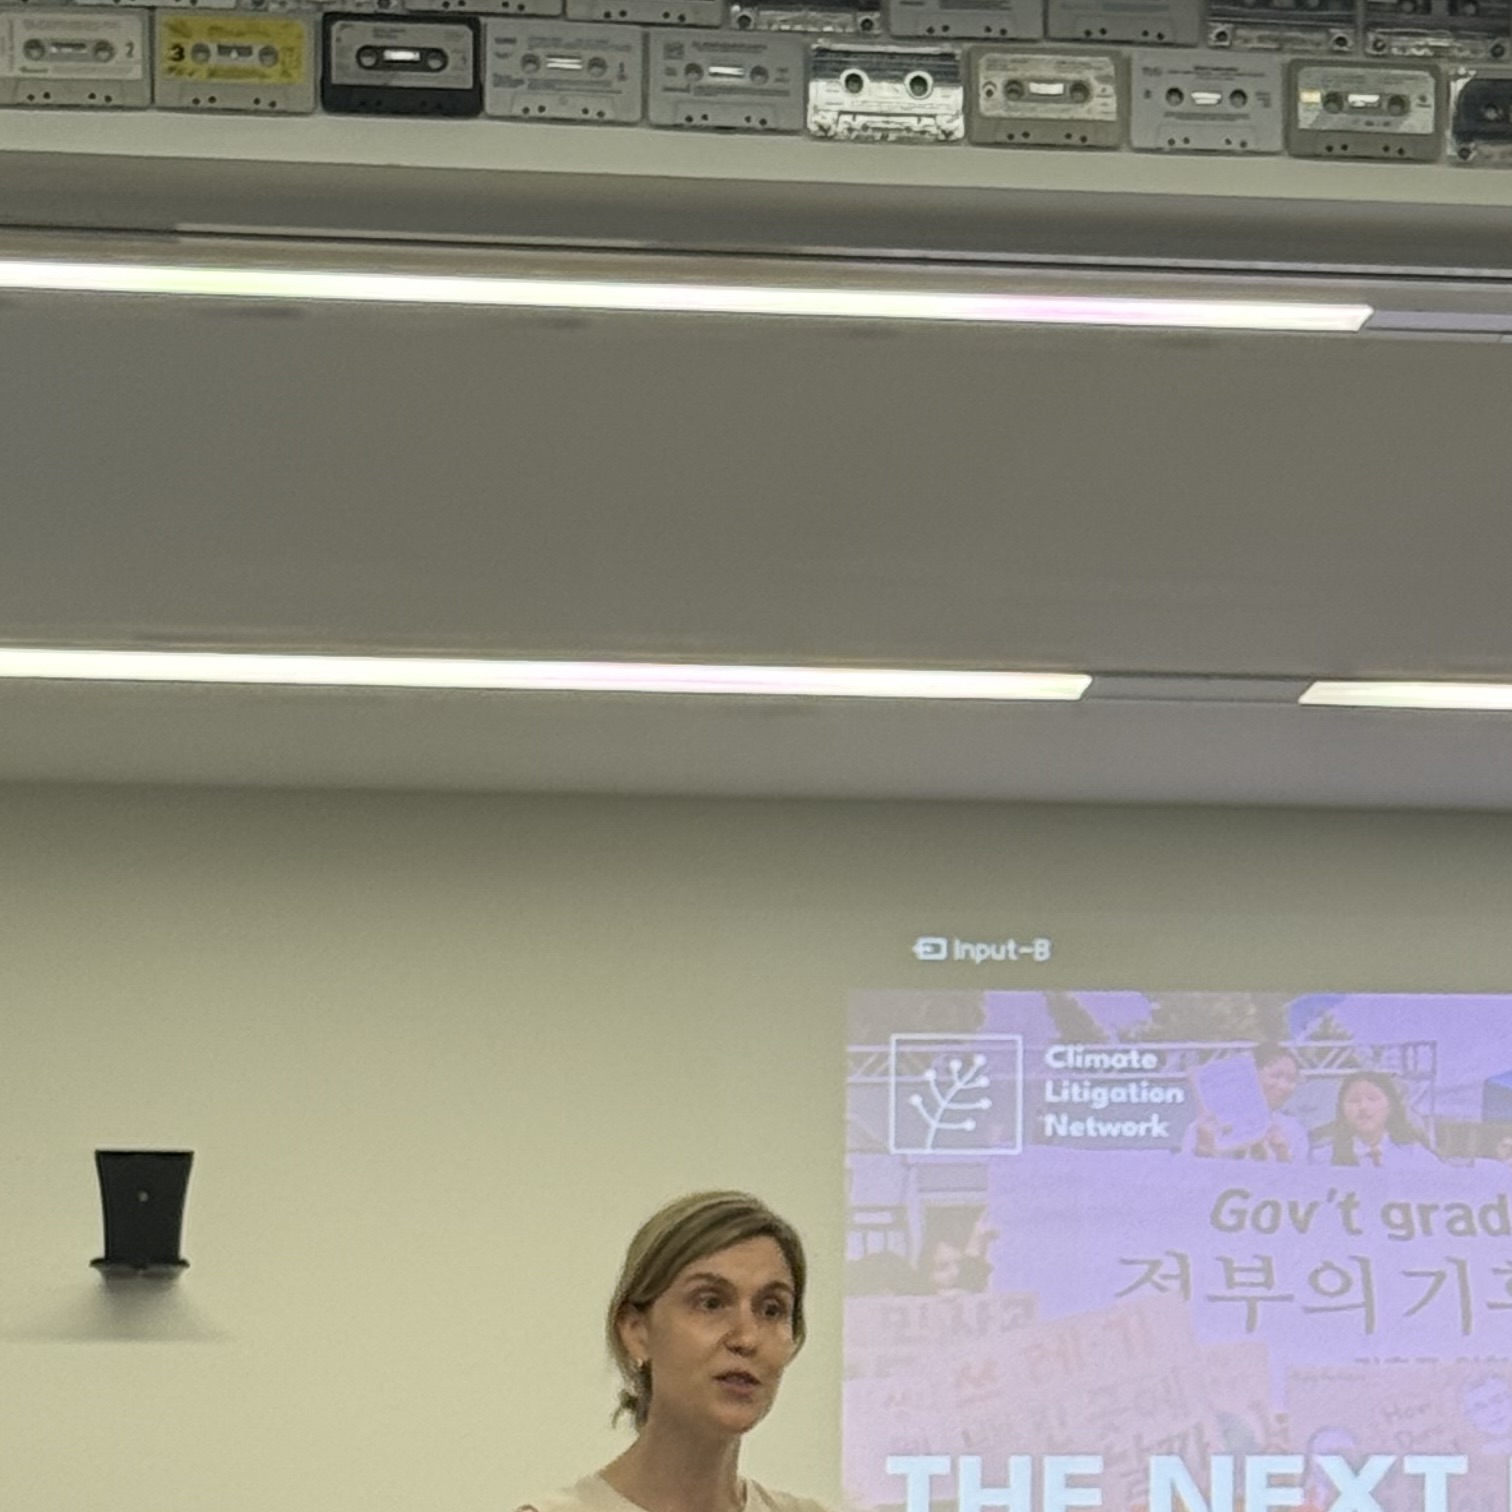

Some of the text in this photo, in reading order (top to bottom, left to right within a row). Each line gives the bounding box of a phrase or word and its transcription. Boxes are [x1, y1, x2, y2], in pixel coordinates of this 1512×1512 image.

[170, 44, 186, 62] 3
[1045, 1044, 1158, 1069] Climate
[1045, 1080, 1185, 1109] Litigation
[1044, 1113, 1170, 1138] Network
[1208, 1187, 1363, 1236] Gov't
